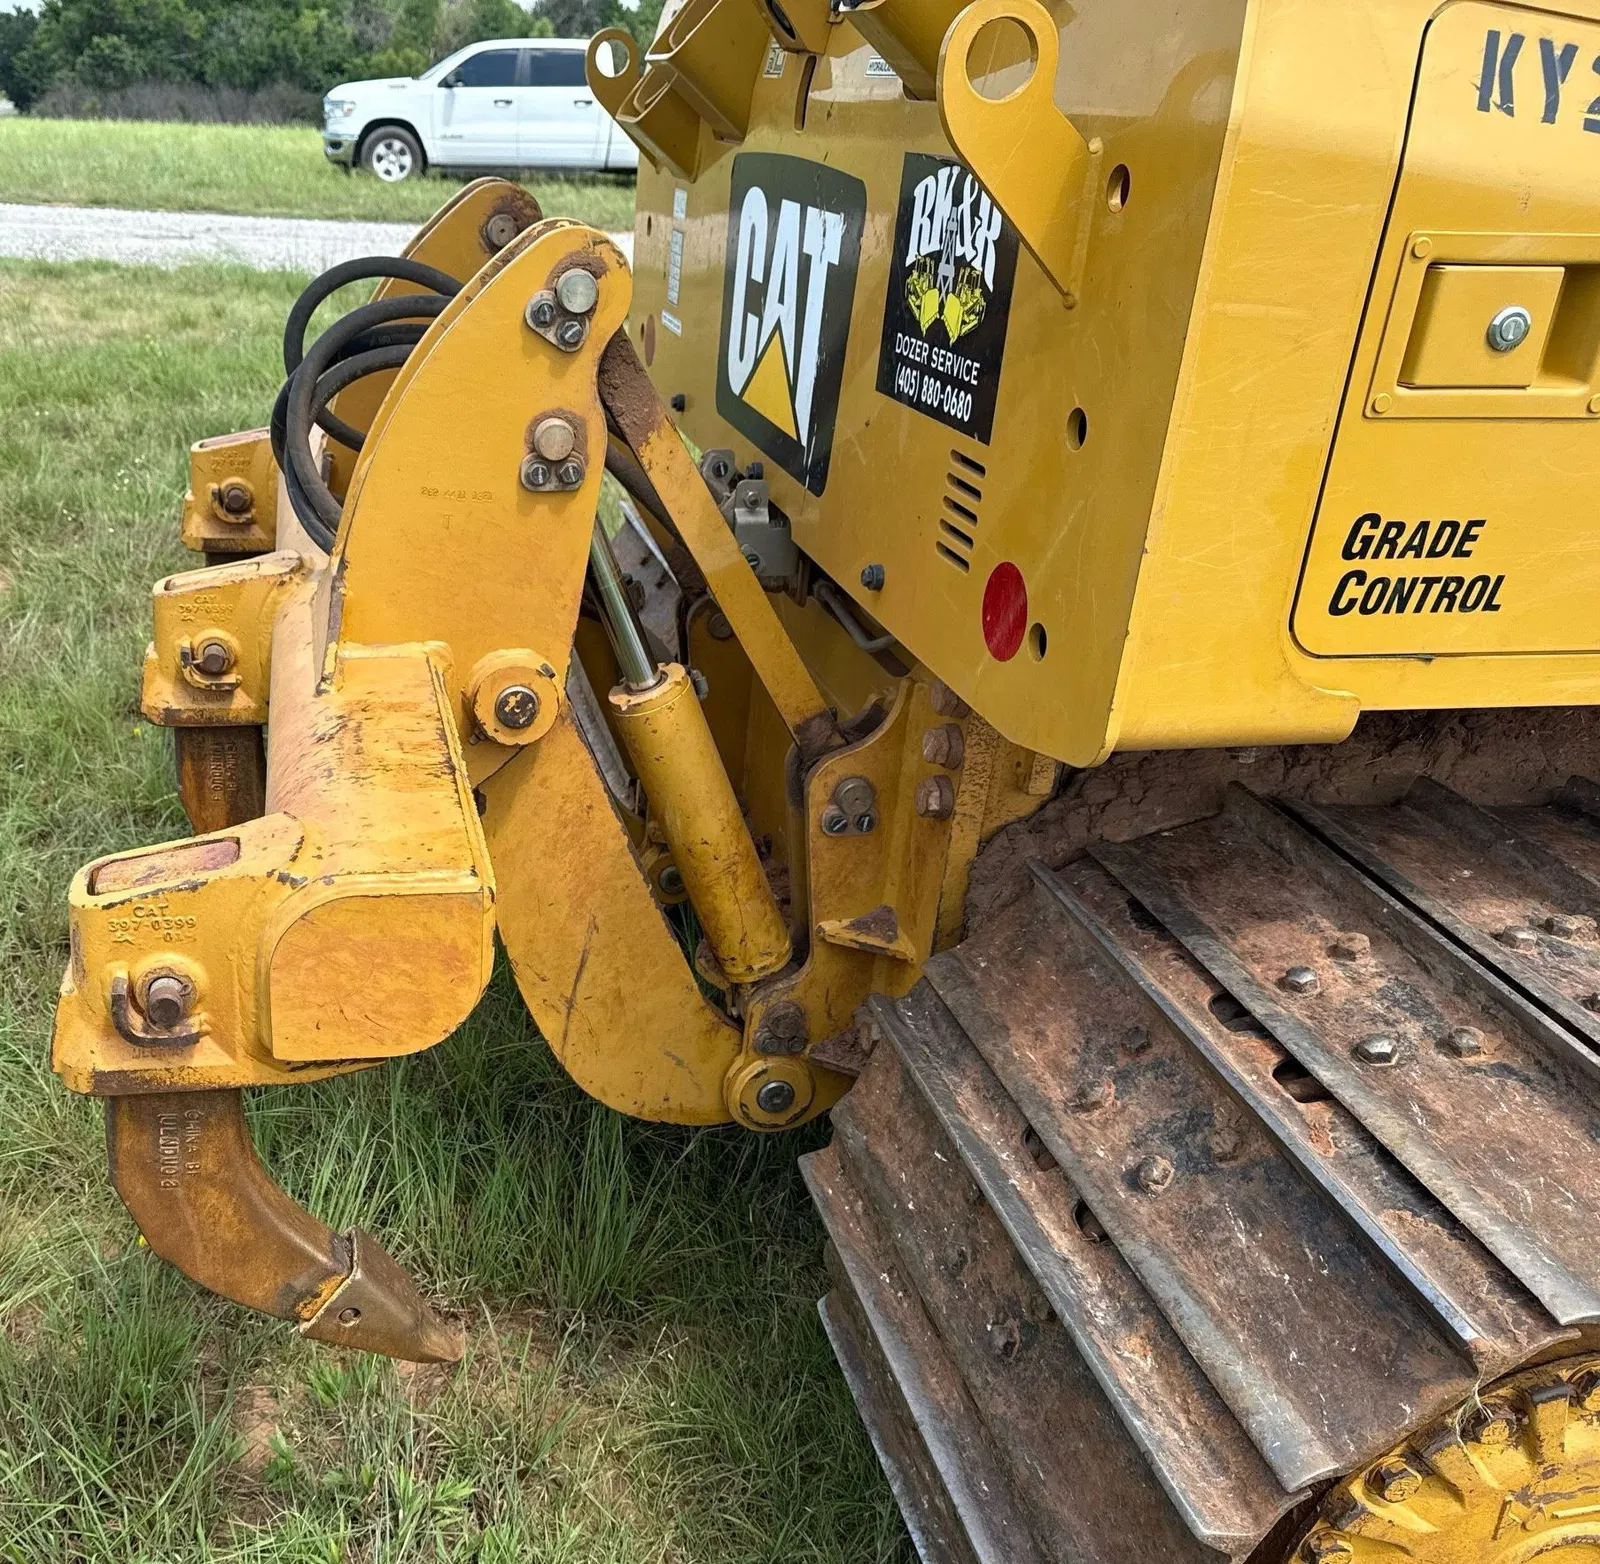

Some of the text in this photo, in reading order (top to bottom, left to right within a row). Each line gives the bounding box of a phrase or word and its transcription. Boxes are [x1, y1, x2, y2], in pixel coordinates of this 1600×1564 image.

[905, 165, 1002, 293] RK&R
[727, 186, 847, 446] CAT
[895, 332, 980, 386] DOZER SERVICE
[895, 362, 972, 422] (405) 880-0680
[1341, 513, 1487, 561] GRADE
[1328, 569, 1505, 616] CONTROL
[133, 904, 169, 918] CAT
